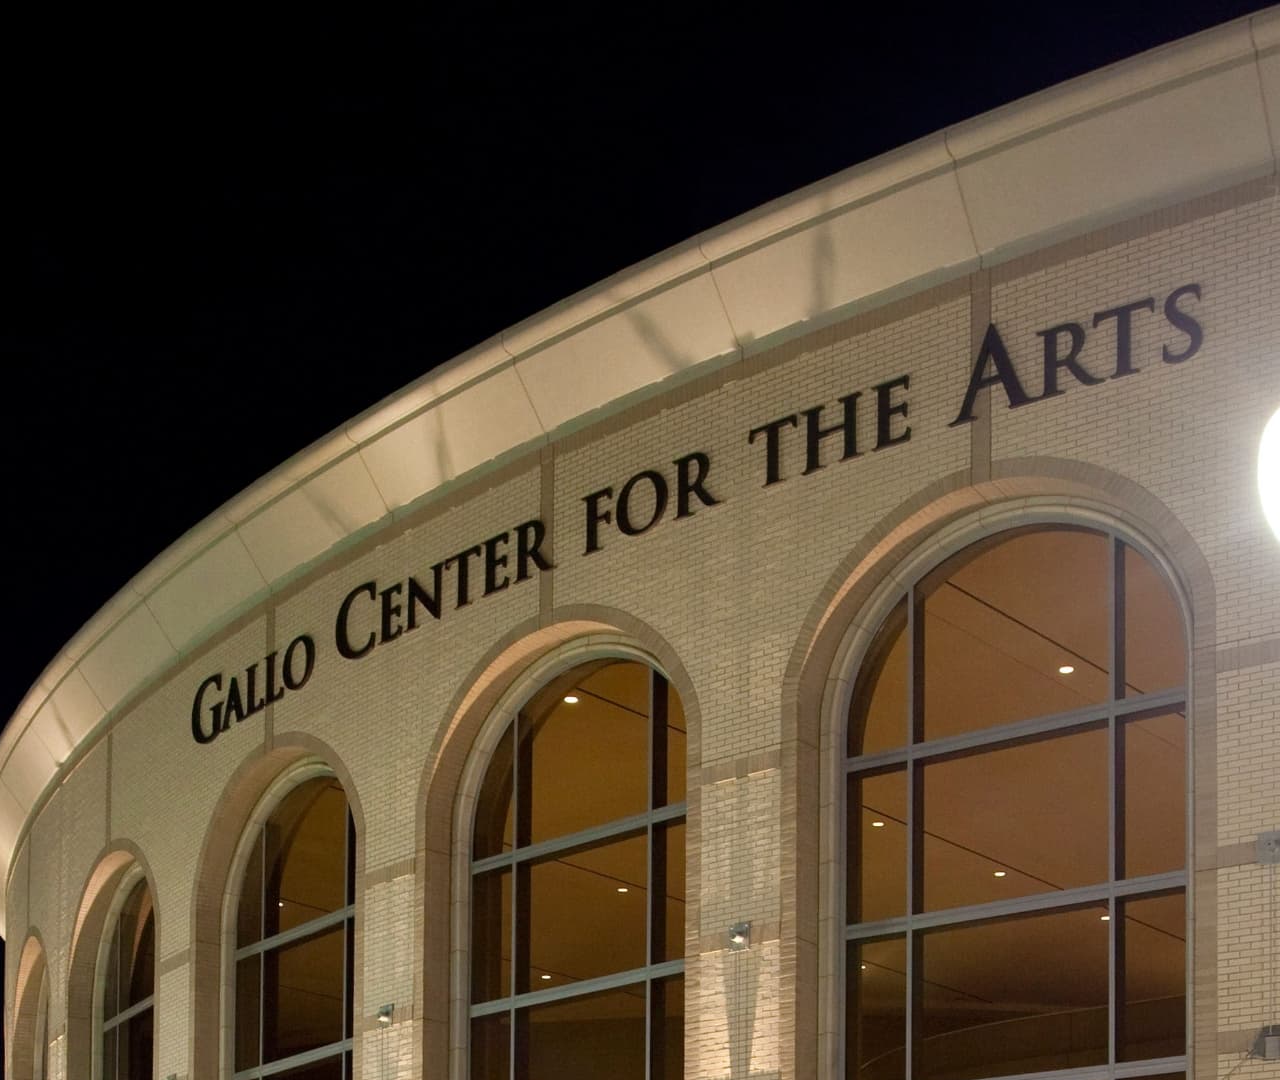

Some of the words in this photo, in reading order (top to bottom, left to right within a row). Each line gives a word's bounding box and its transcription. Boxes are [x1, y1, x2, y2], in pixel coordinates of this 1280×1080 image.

[191, 633, 316, 745] GALLO
[335, 519, 557, 660] CENTER
[581, 451, 720, 557] FOR
[747, 374, 913, 488] THE
[948, 282, 1205, 428] ARTS
